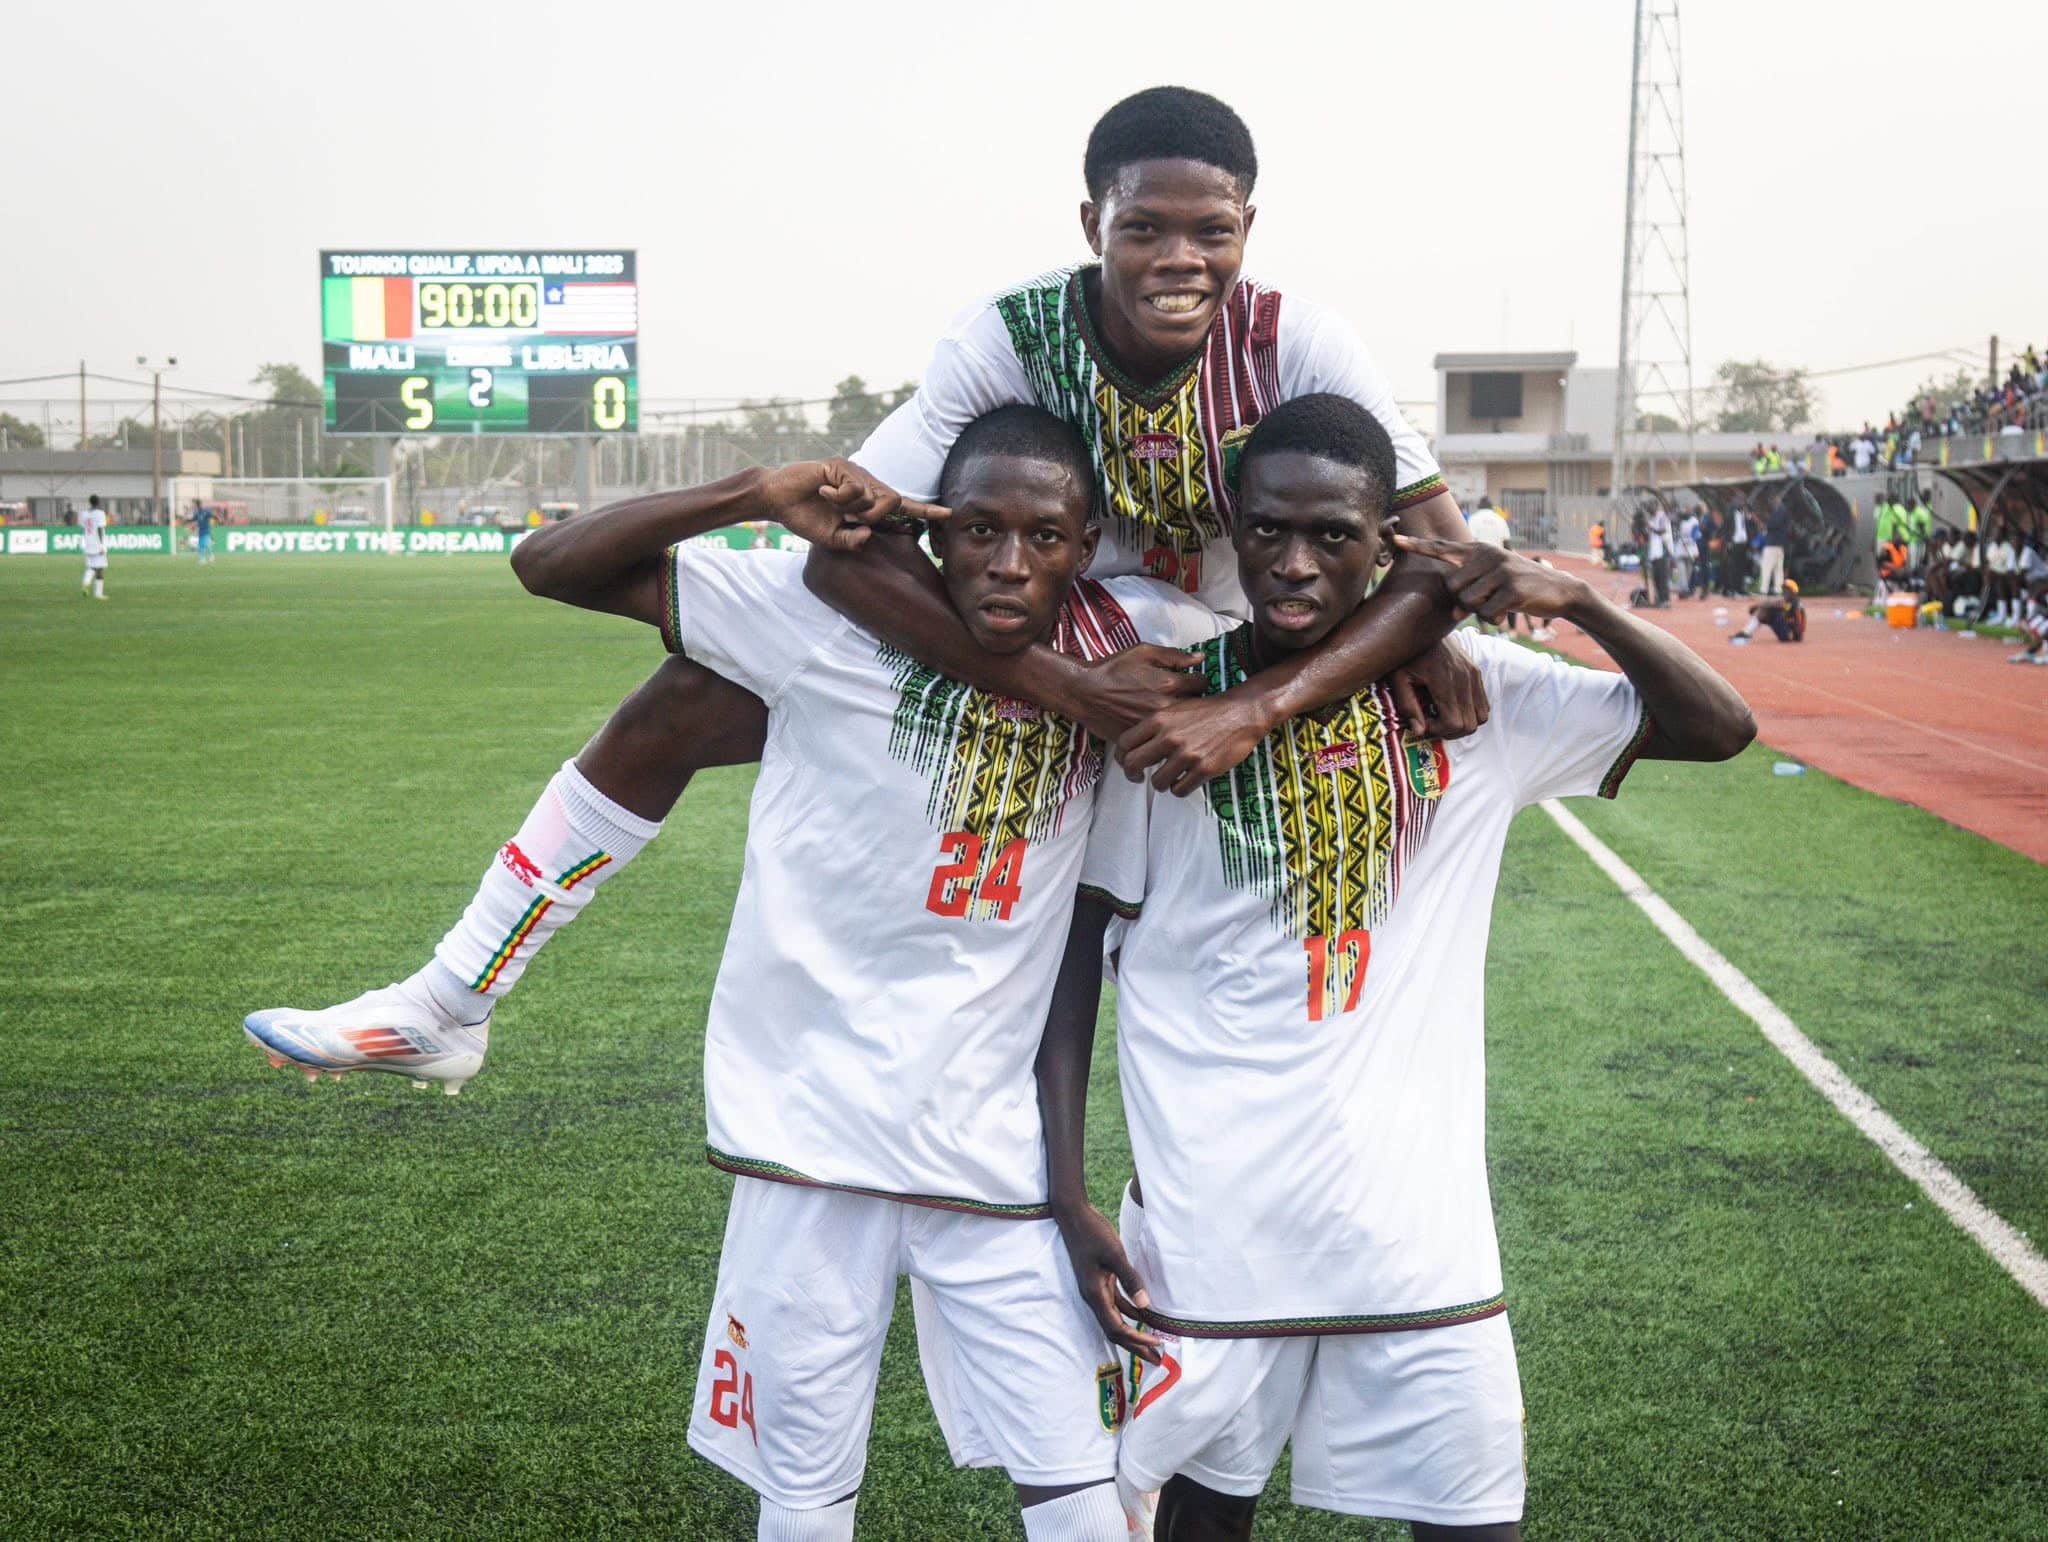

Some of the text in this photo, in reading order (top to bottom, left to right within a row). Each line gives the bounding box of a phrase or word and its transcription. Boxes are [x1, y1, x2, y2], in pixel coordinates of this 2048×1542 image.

[541, 256, 583, 274] MALI
[421, 284, 537, 327] 90:00
[349, 345, 416, 370] MALI
[522, 345, 629, 370] LIBERIA
[400, 376, 434, 430] 5
[468, 368, 493, 407] 2
[593, 376, 626, 430] 0
[227, 531, 348, 553] PROTECT
[351, 531, 405, 553] THE
[410, 531, 503, 553] DREAM
[926, 831, 1028, 921] 24
[1303, 928, 1371, 1022] 17
[710, 1348, 758, 1448] 24
